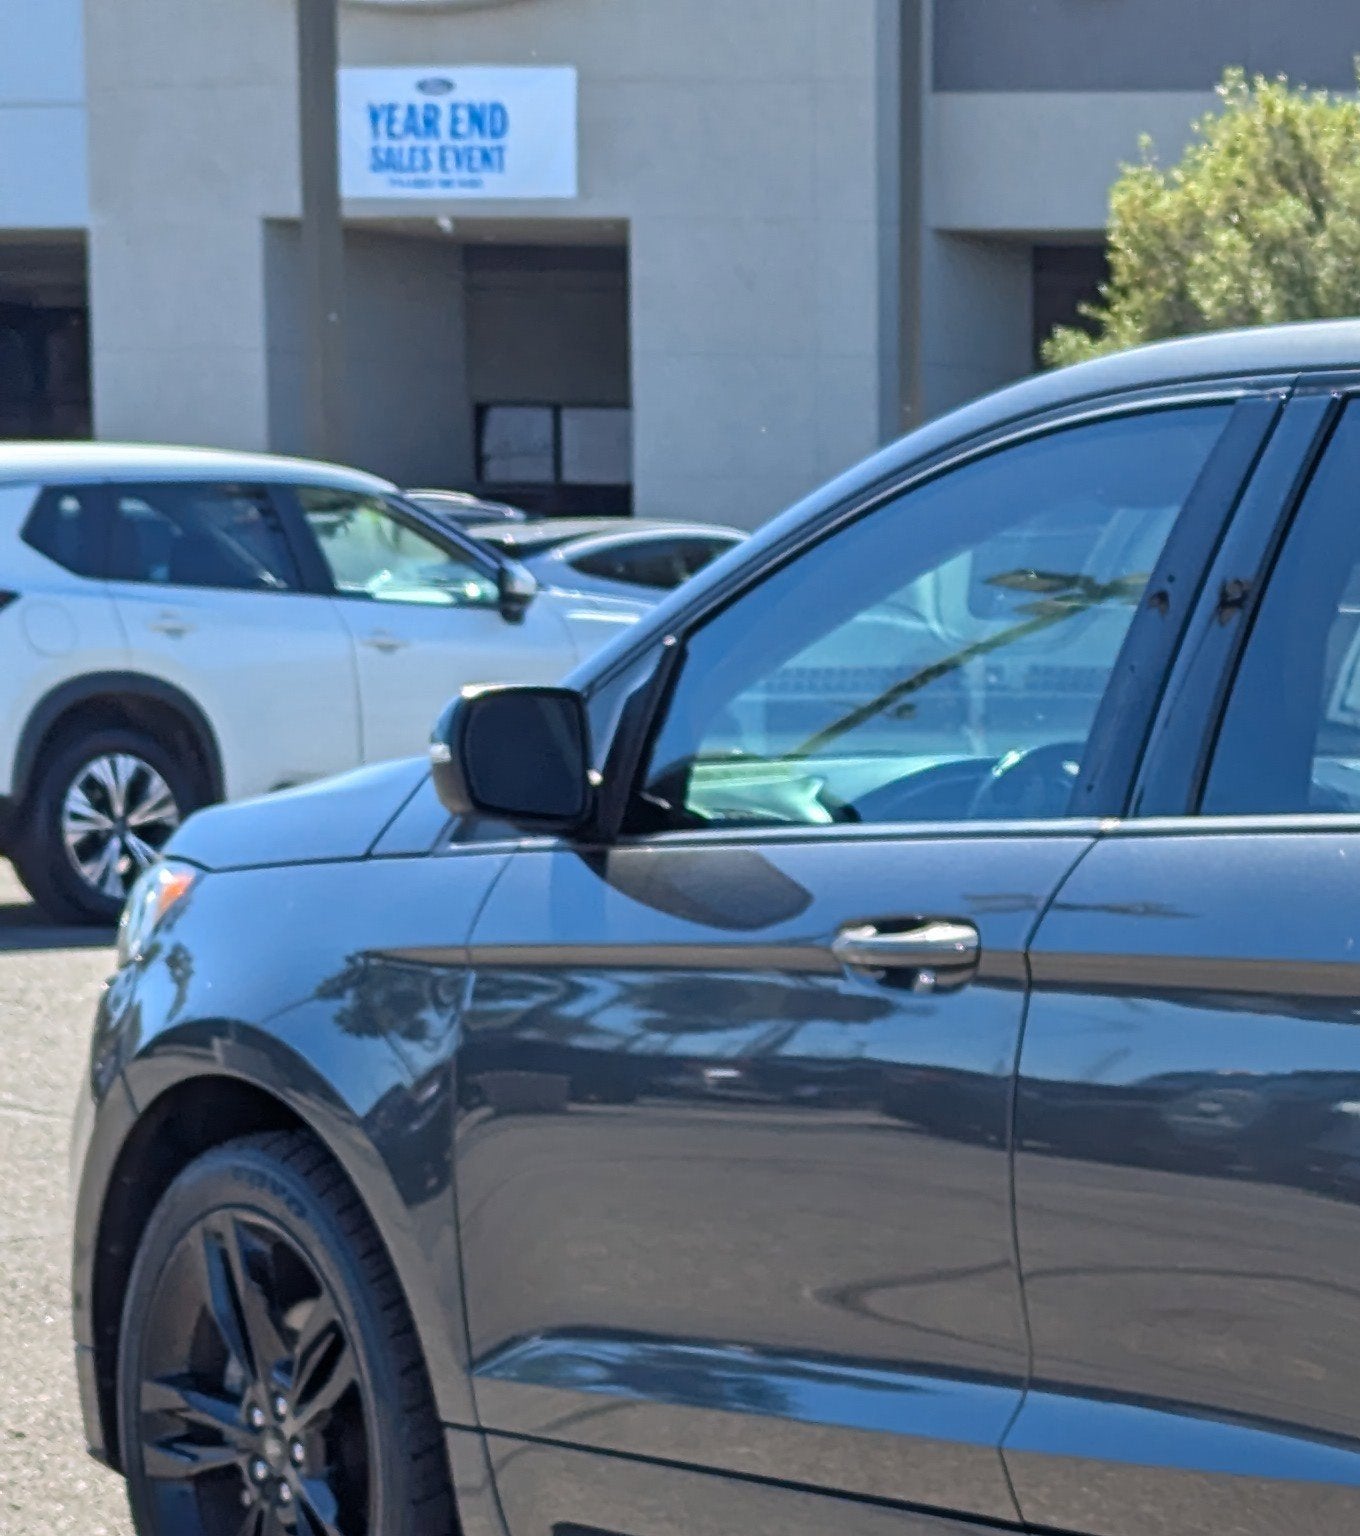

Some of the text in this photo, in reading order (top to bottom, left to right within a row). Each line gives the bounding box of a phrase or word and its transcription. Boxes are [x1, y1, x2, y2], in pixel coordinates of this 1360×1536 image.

[367, 102, 509, 140] YEAR END
[369, 145, 505, 173] SALES EVENT
